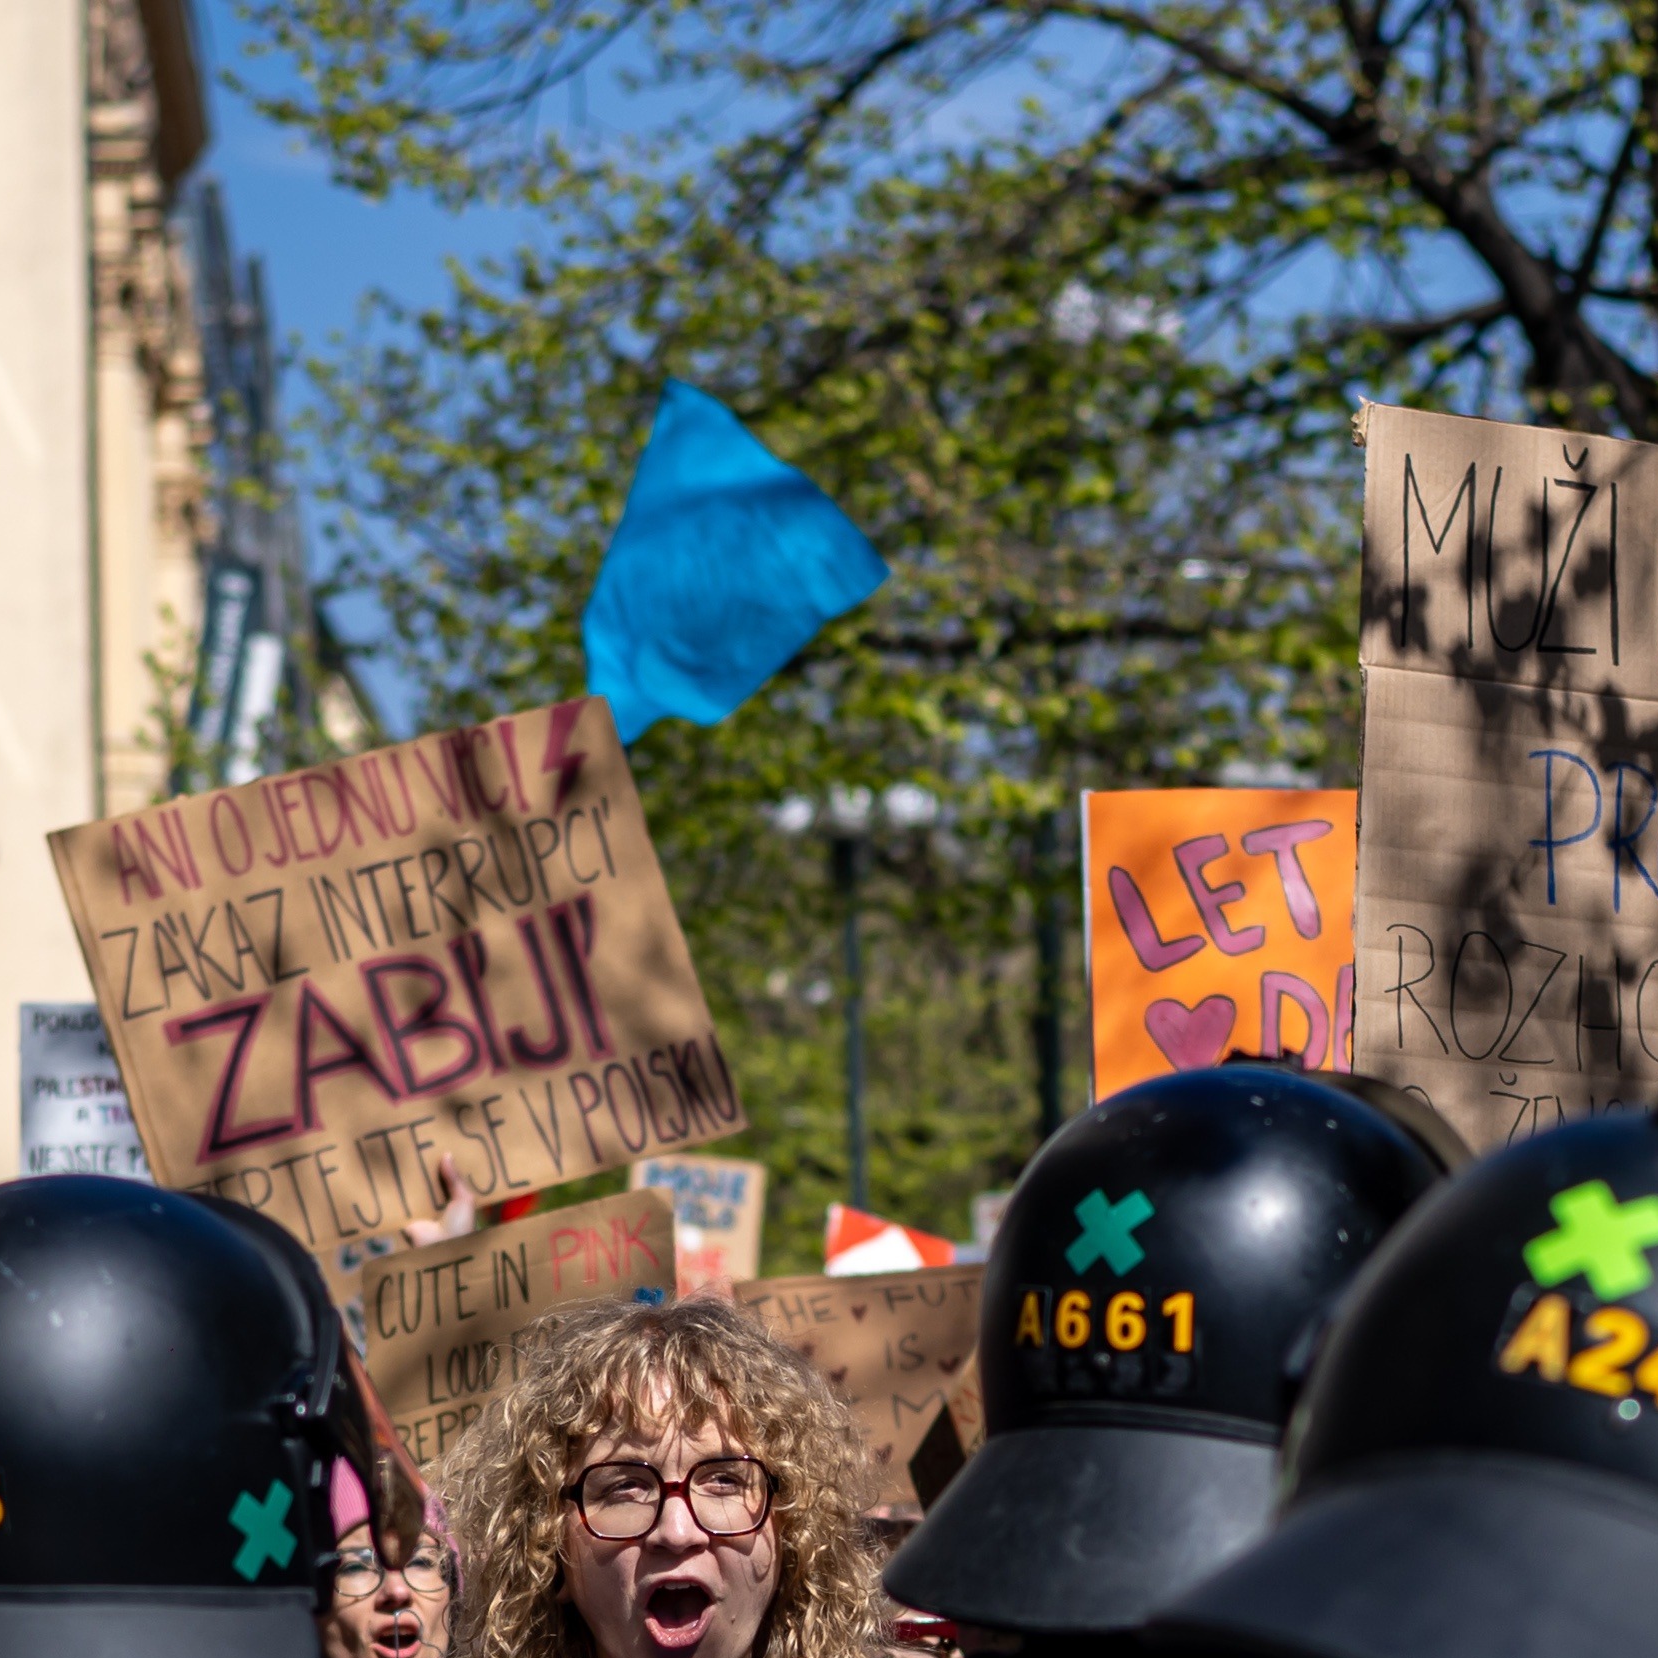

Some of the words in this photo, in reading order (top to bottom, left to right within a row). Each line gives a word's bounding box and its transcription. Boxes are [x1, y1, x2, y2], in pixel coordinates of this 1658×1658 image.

[1399, 444, 1621, 668] MUŽI
[107, 806, 204, 905] ANI
[210, 793, 255, 877] O
[261, 750, 421, 870] JEDNU
[1108, 819, 1335, 973] LET
[100, 888, 311, 1023] ZÁKAZ
[307, 796, 617, 964] INTERRUPCÍ
[163, 892, 615, 1168] ZABÍJÍ
[451, 1092, 535, 1196] SE
[516, 1080, 567, 1178] V
[567, 1032, 740, 1166] POLSKU
[375, 1253, 479, 1340] CUTE
[492, 1242, 532, 1310] IN
[548, 1211, 660, 1294] PINK
[742, 1294, 835, 1327] THE
[1015, 1289, 1195, 1354] A661
[427, 1339, 500, 1405] LOUD
